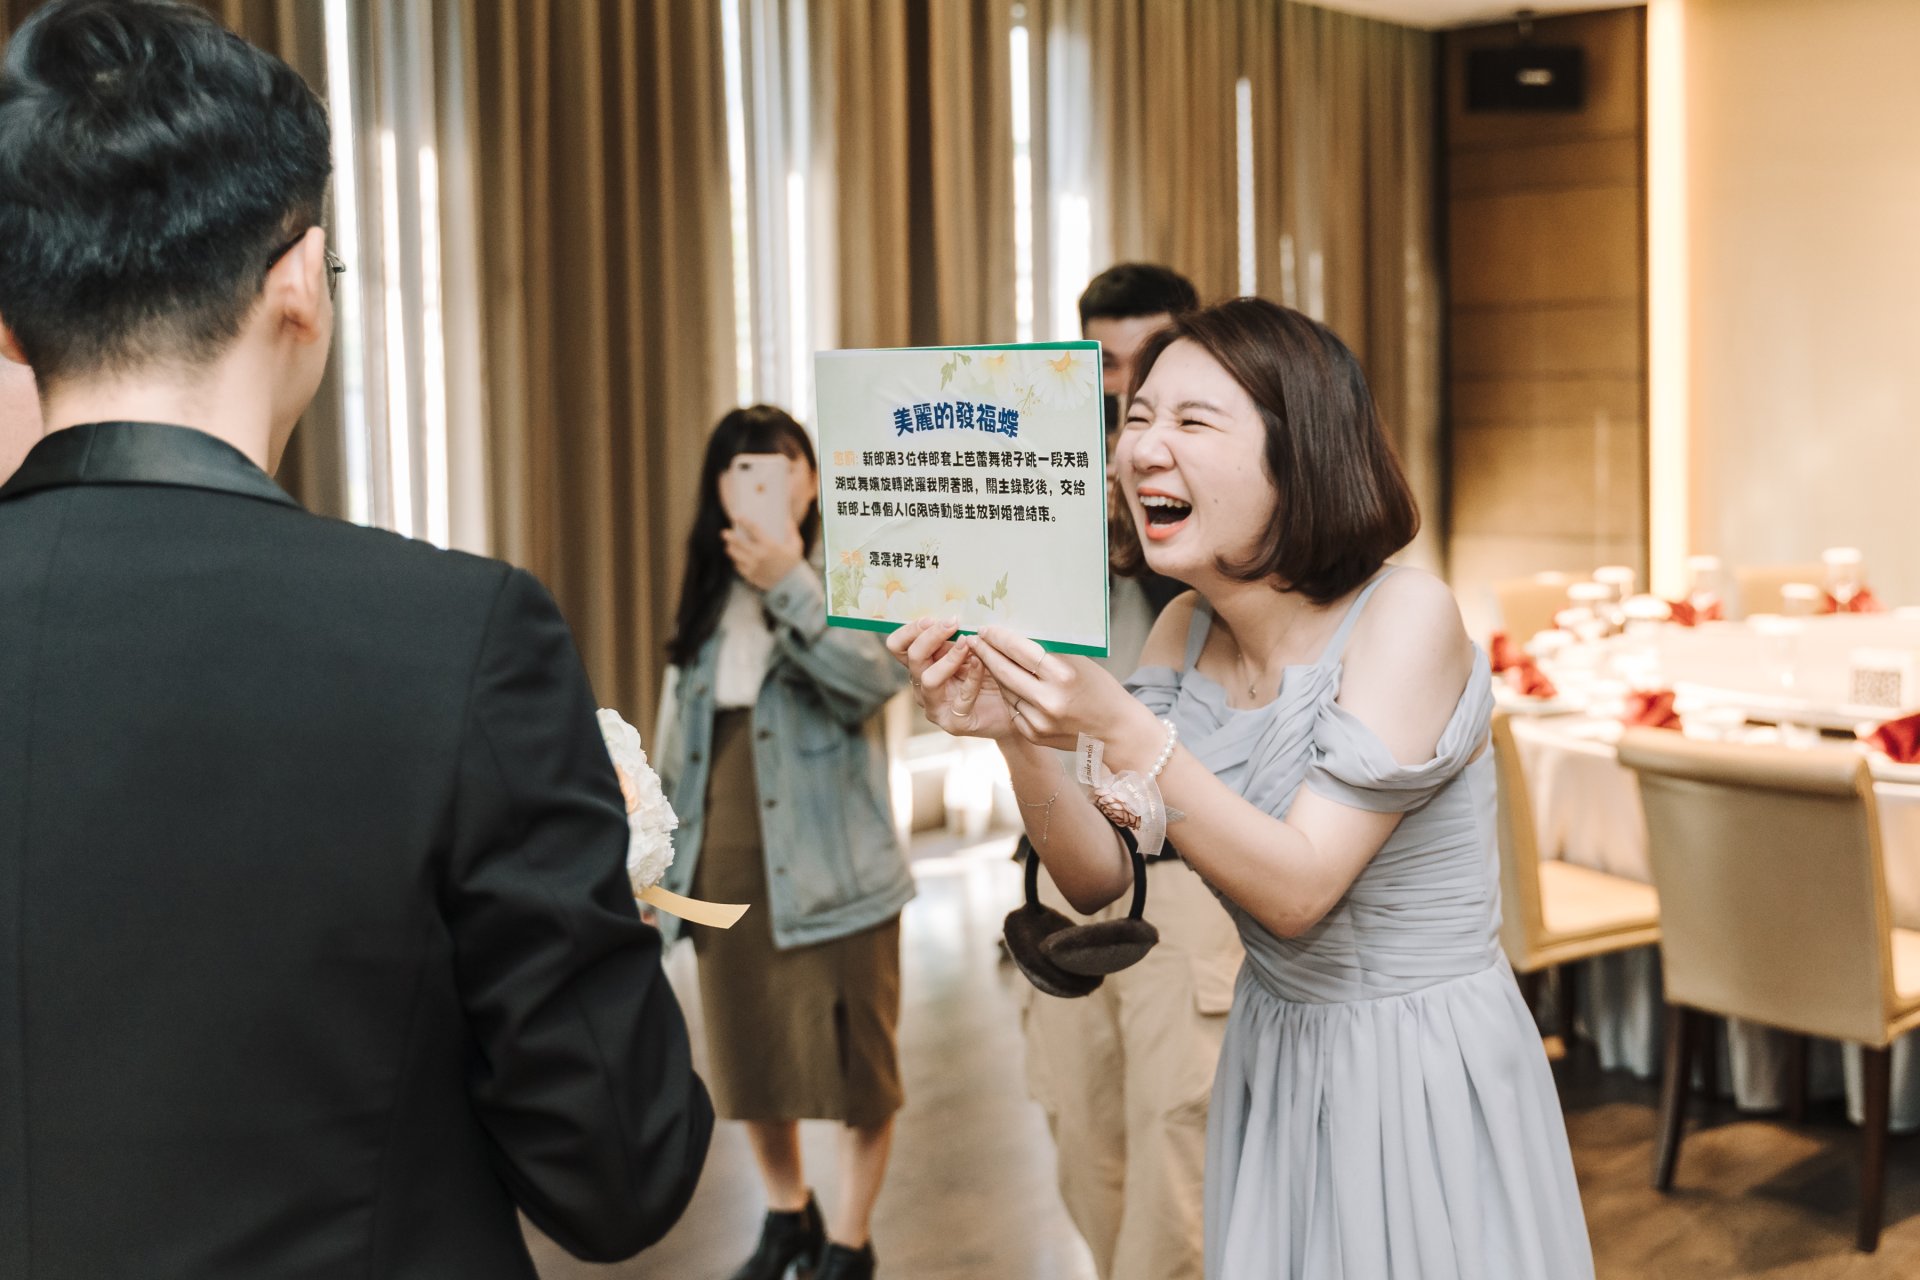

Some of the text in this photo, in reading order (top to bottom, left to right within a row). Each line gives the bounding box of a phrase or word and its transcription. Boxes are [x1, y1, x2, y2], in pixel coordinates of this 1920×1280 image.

[893, 401, 1019, 438] 美麗的發福蝶
[1086, 744, 1094, 759] wish
